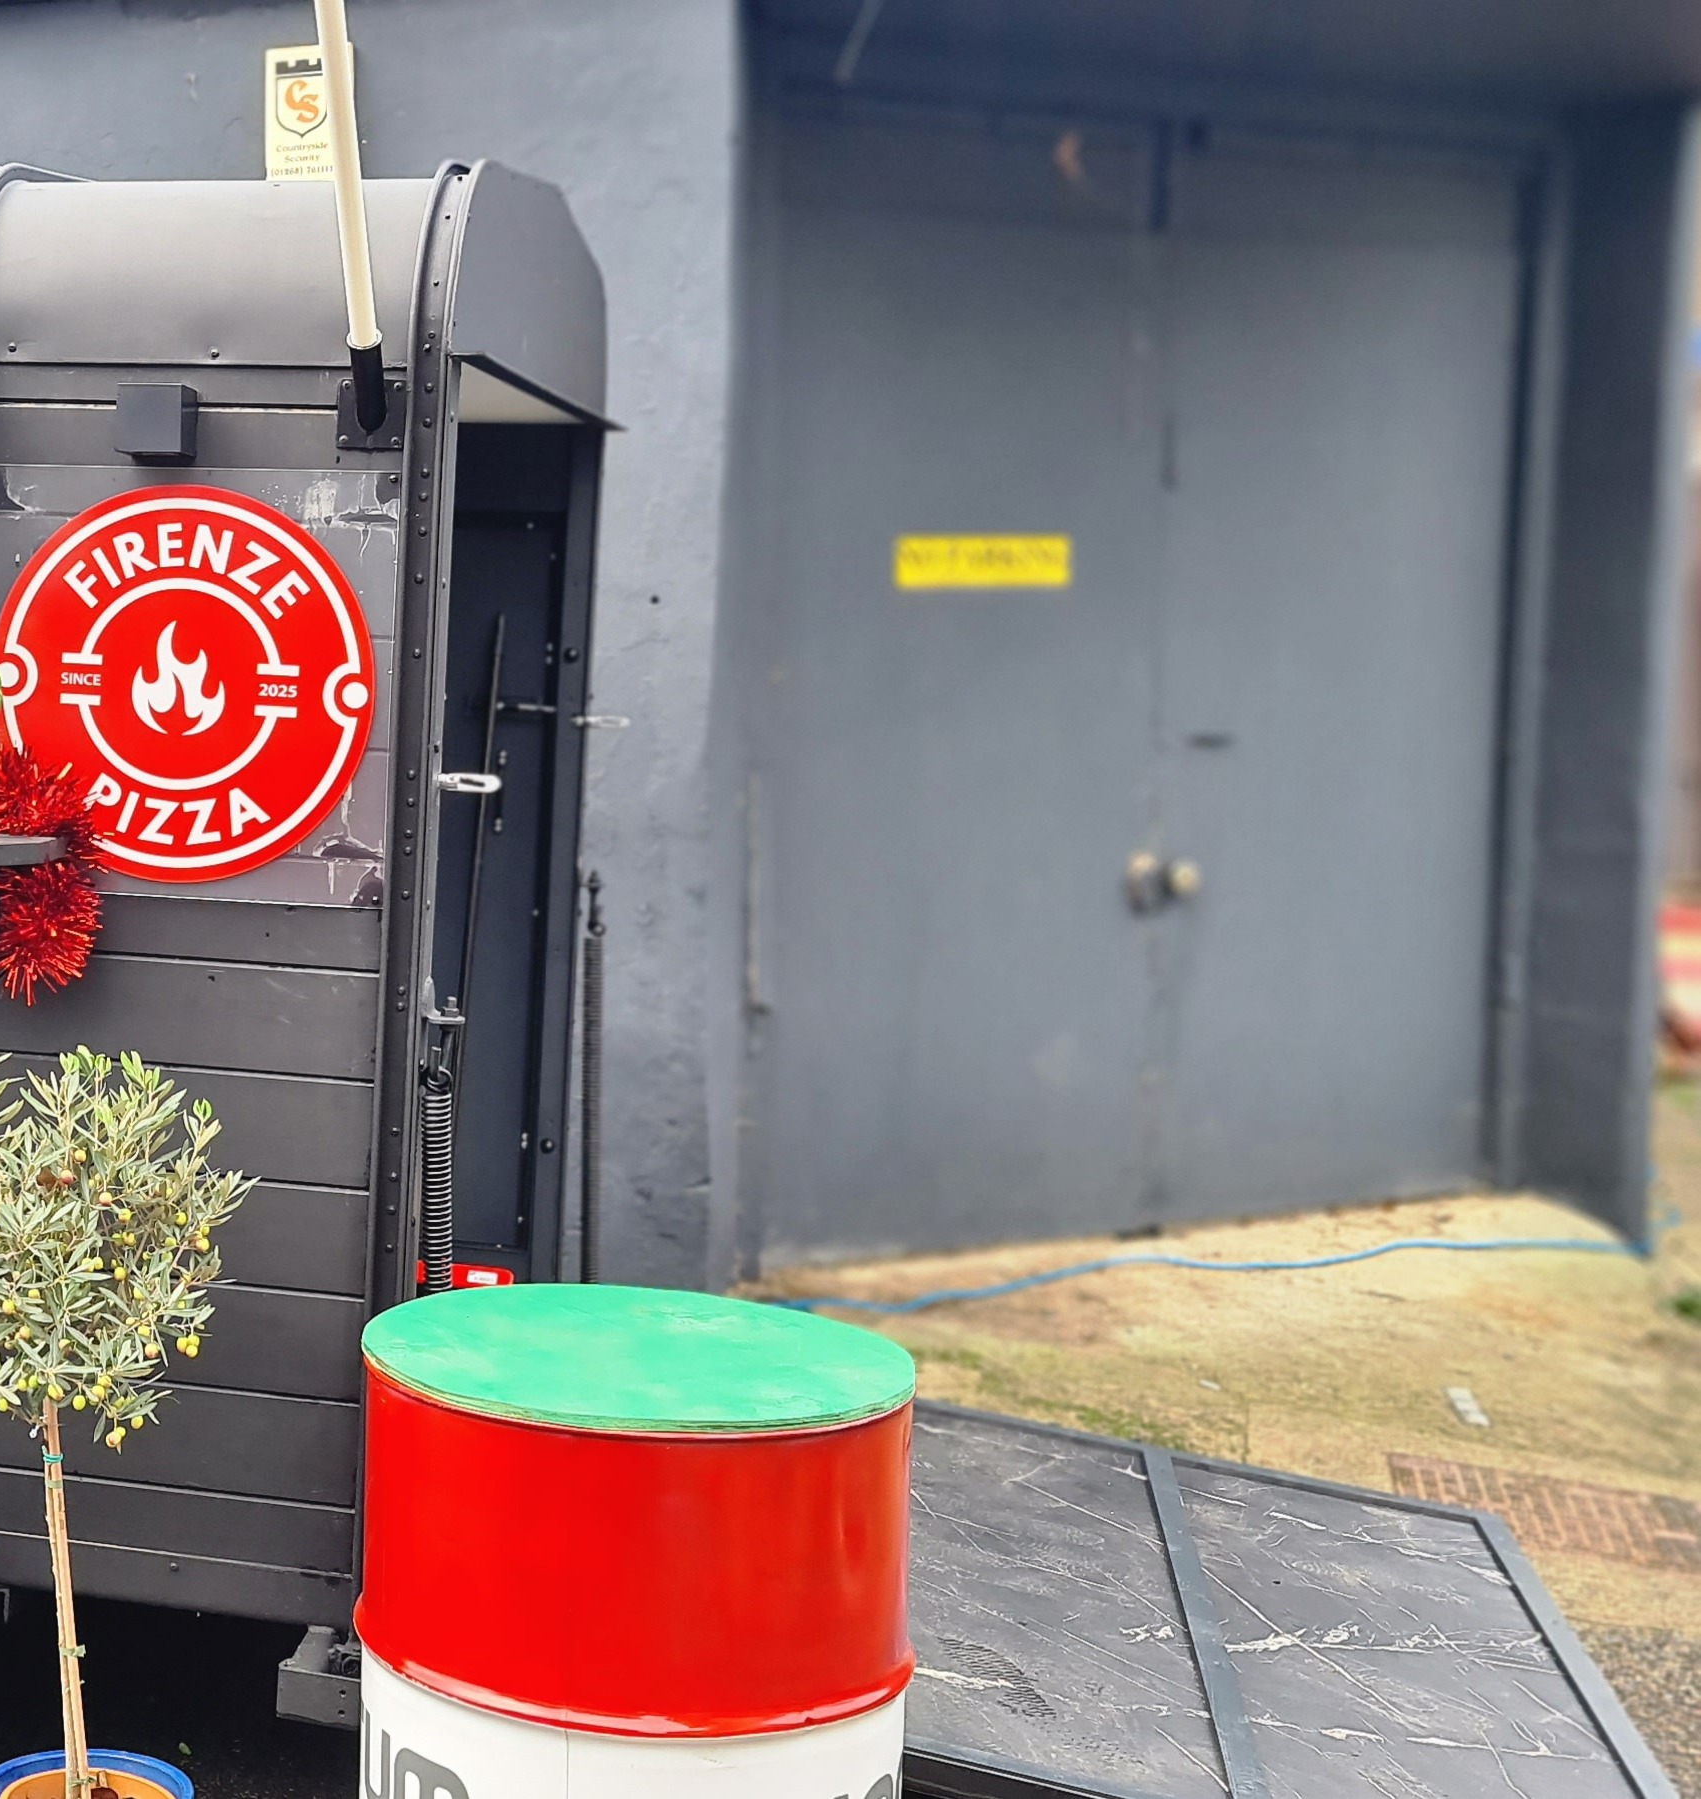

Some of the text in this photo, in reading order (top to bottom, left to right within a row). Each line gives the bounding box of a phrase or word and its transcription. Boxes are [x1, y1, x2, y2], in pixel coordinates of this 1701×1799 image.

[62, 522, 311, 620] FIRENZE
[60, 671, 102, 687] SINCE
[258, 682, 298, 699] 2025
[82, 772, 271, 847] PIZZA
